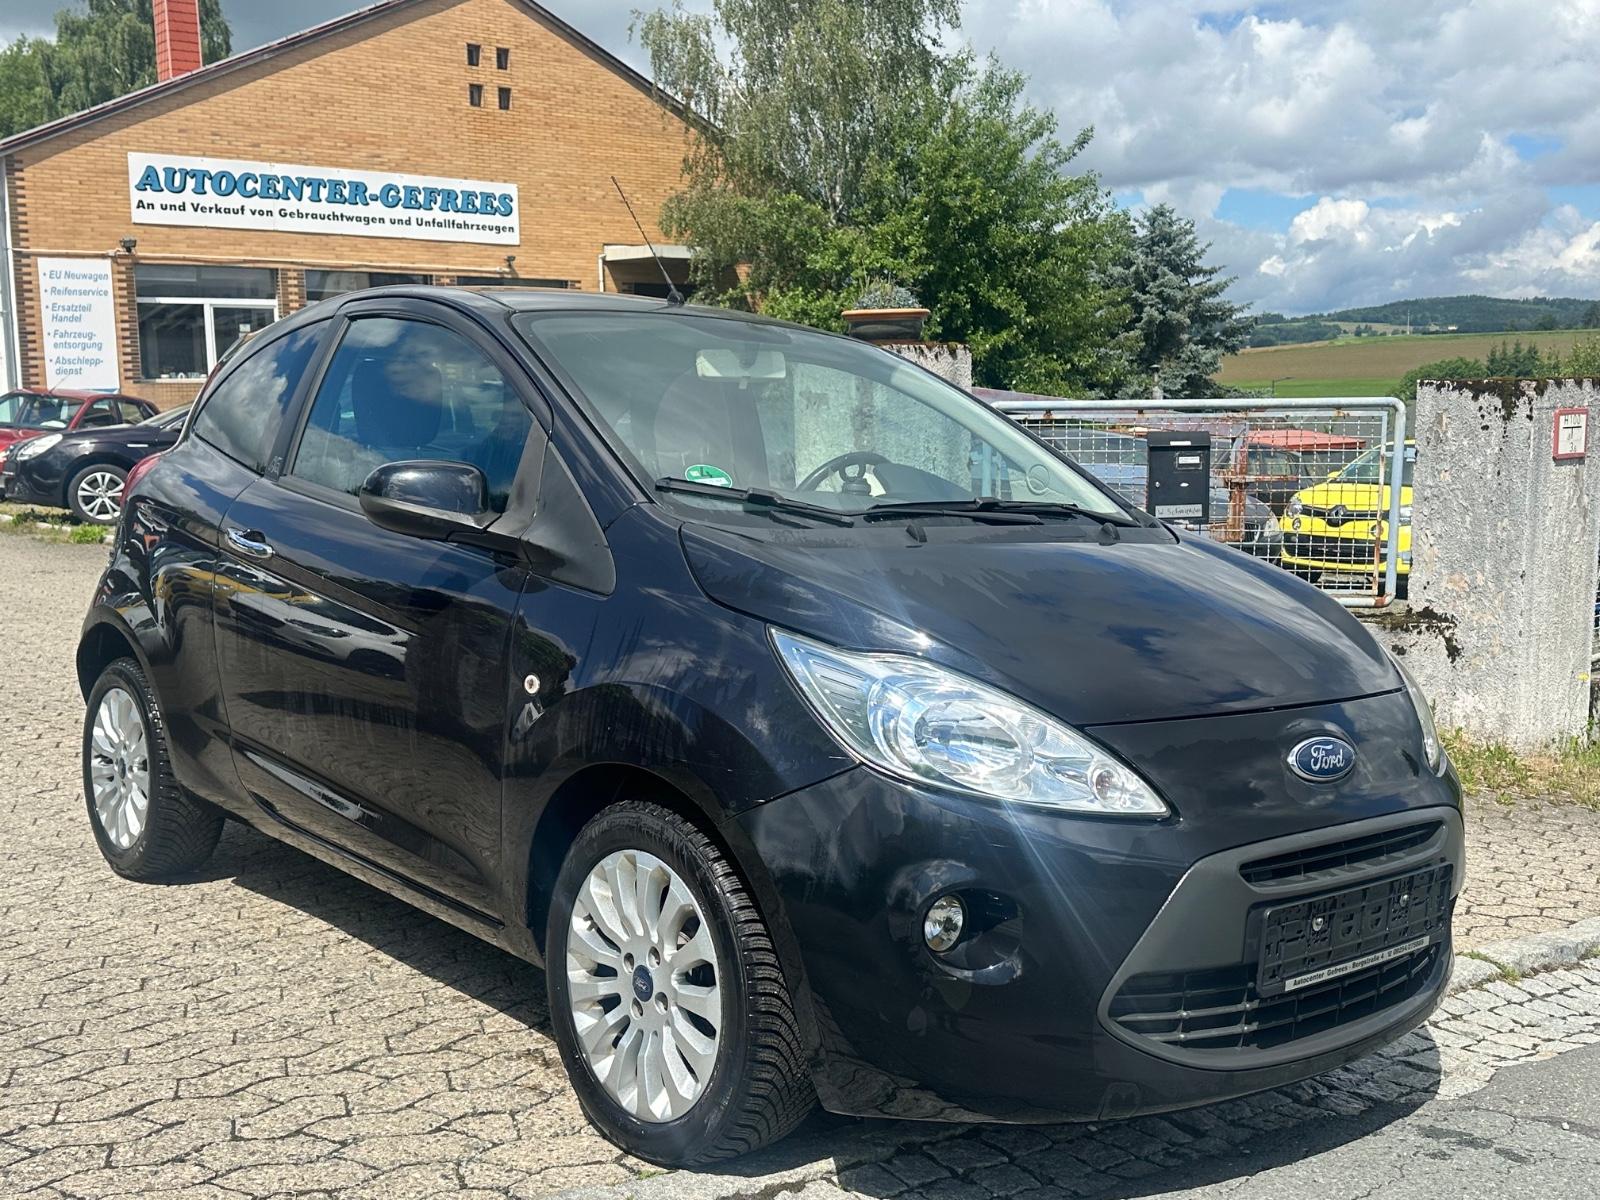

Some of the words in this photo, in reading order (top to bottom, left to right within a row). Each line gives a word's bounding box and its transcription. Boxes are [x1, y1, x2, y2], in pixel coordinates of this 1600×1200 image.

[135, 165, 514, 217] AUTOCENTER-GEFREES
[136, 200, 155, 210] An
[160, 202, 186, 212] und
[190, 202, 246, 216] Verkauf
[250, 209, 274, 217] von
[279, 208, 386, 226] Gebrauchtwagen
[390, 216, 412, 226] und
[416, 218, 515, 235] Unfallfahrzeugen
[49, 270, 62, 280] EU
[64, 270, 109, 283] Neuwagen
[50, 287, 109, 297] Reifenservice
[51, 303, 92, 313] Ersatzteil
[51, 314, 82, 323] Handel
[53, 329, 97, 341] Fahrzeug-
[53, 341, 103, 351] entsorgung
[55, 356, 104, 367] Abschlepp-
[55, 367, 83, 375] dienst
[1310, 744, 1345, 771] Ford
[1293, 972, 1325, 986] Autocenter
